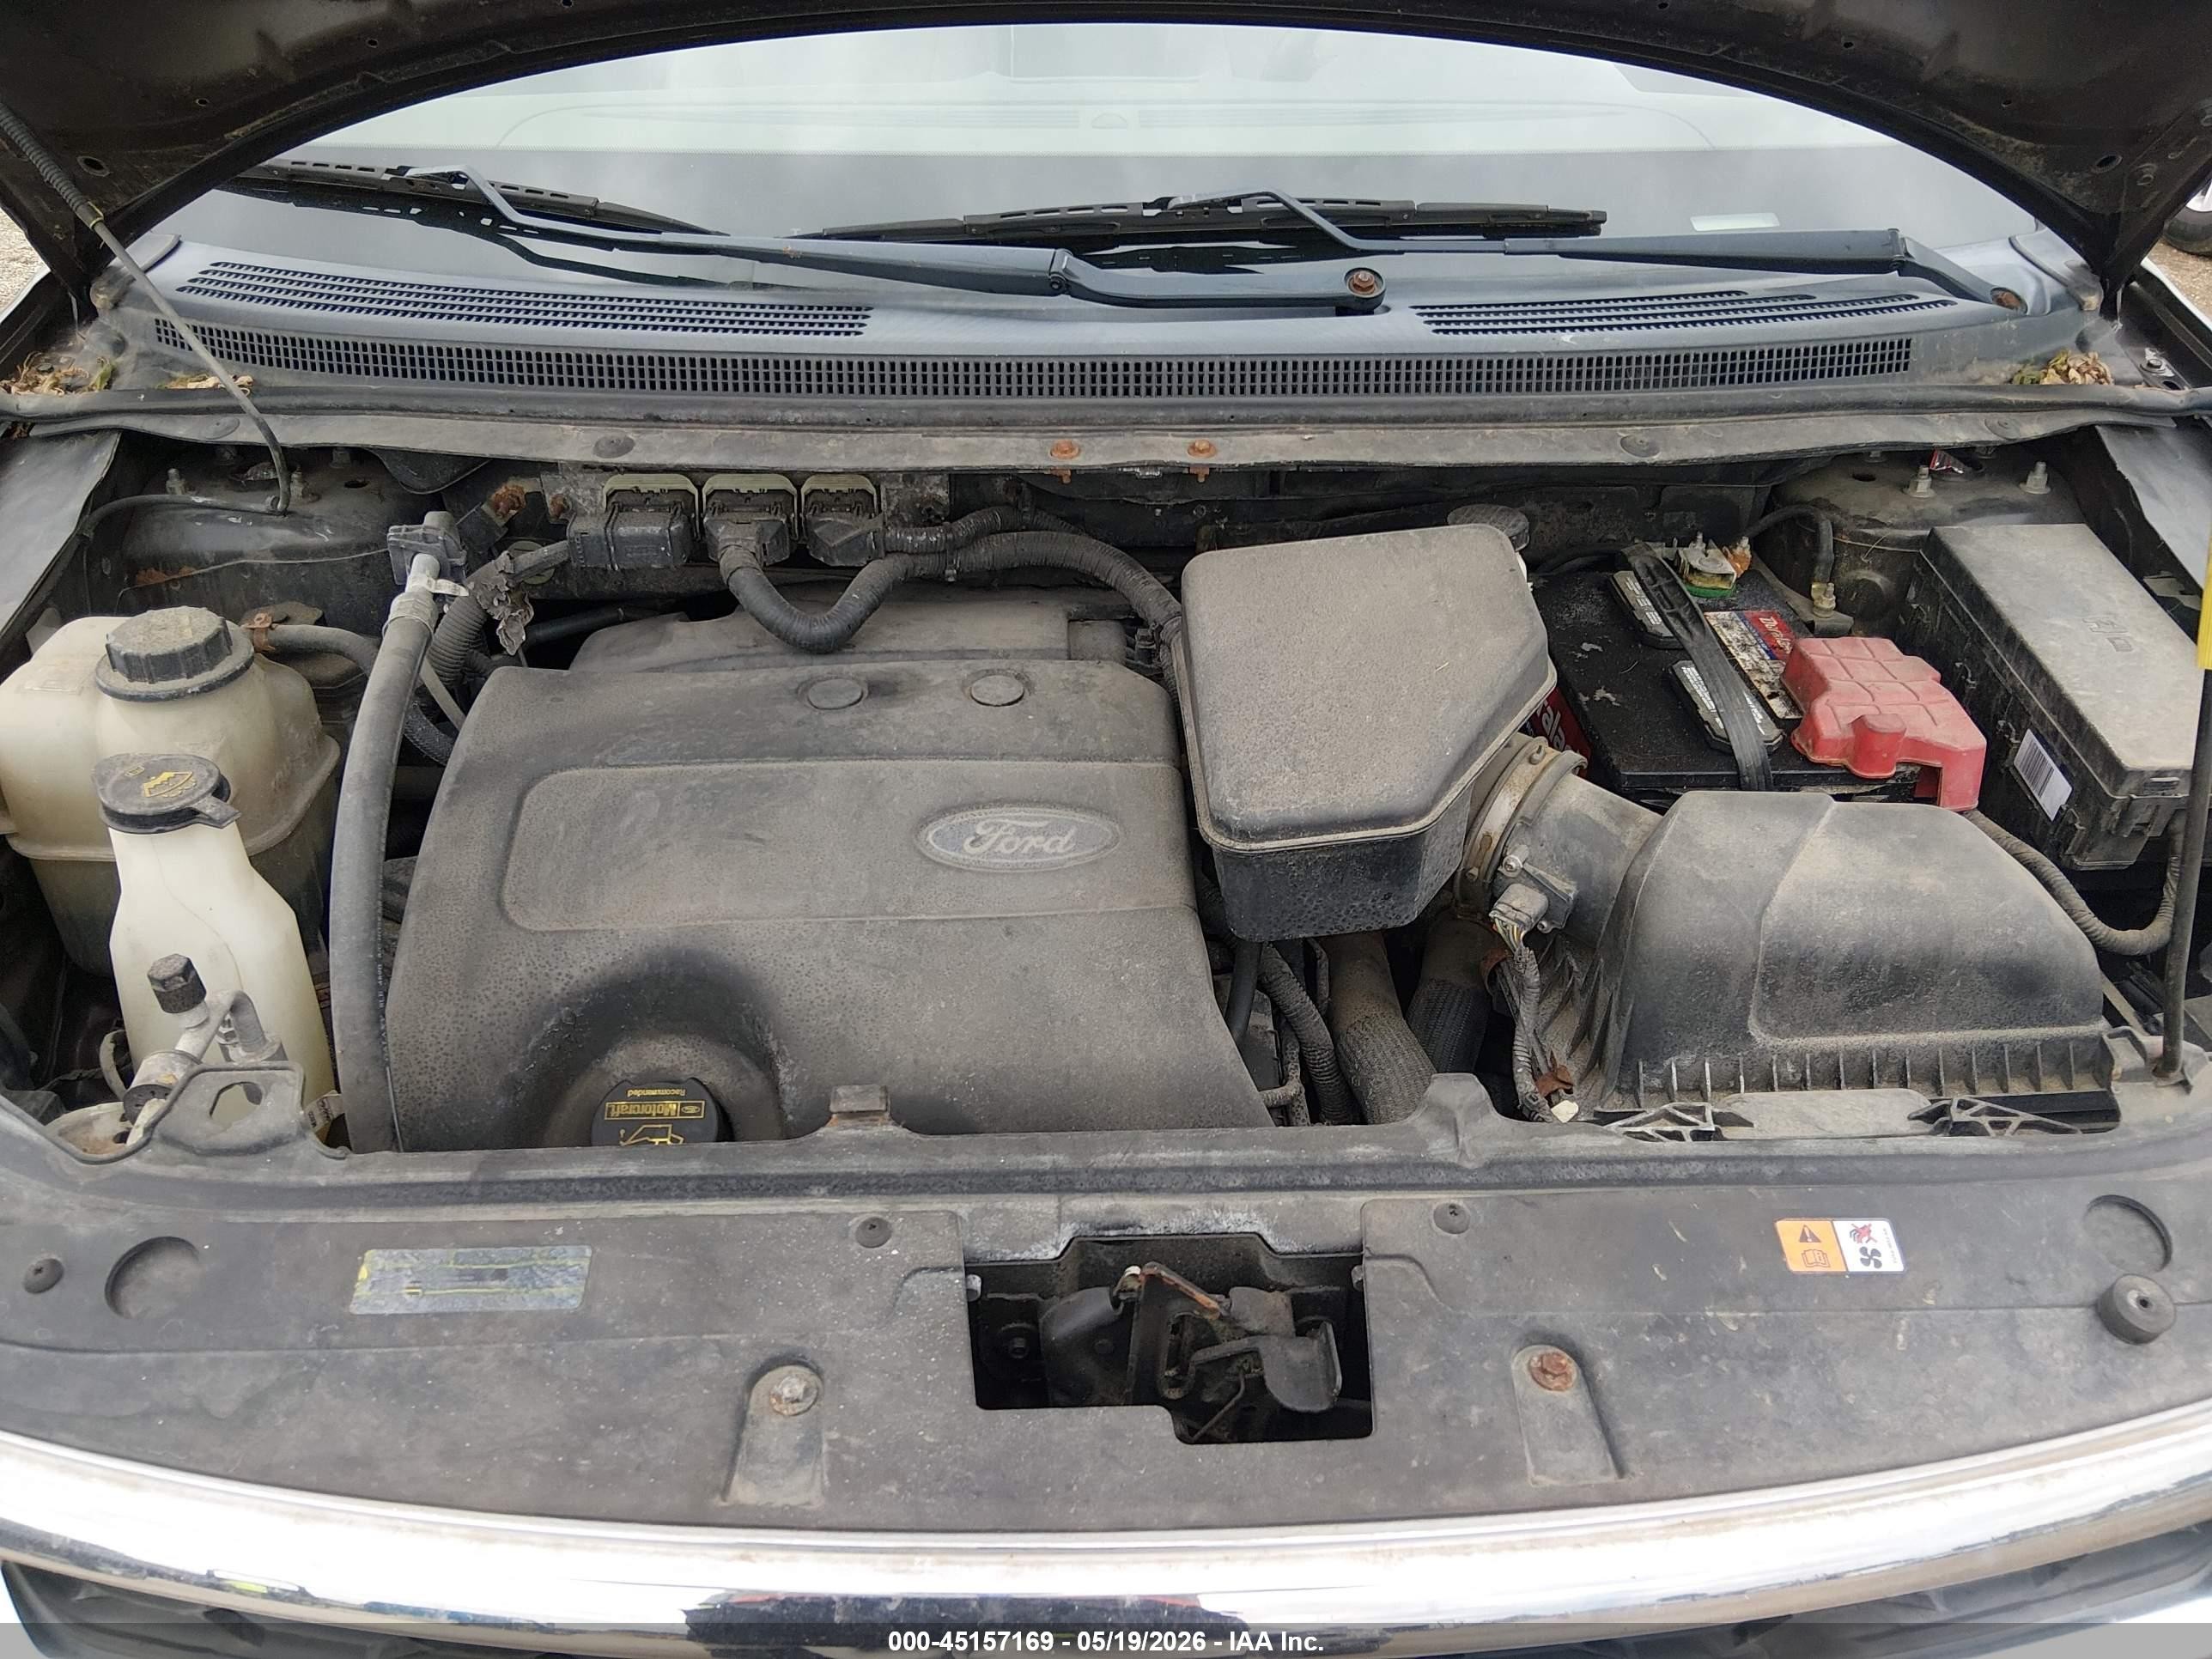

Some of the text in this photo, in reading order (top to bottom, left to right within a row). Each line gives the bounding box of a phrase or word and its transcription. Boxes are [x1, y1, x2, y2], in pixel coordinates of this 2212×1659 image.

[963, 818, 1078, 854] Ford
[627, 1089, 685, 1097] Recommended
[610, 1103, 677, 1117] Motorcraft
